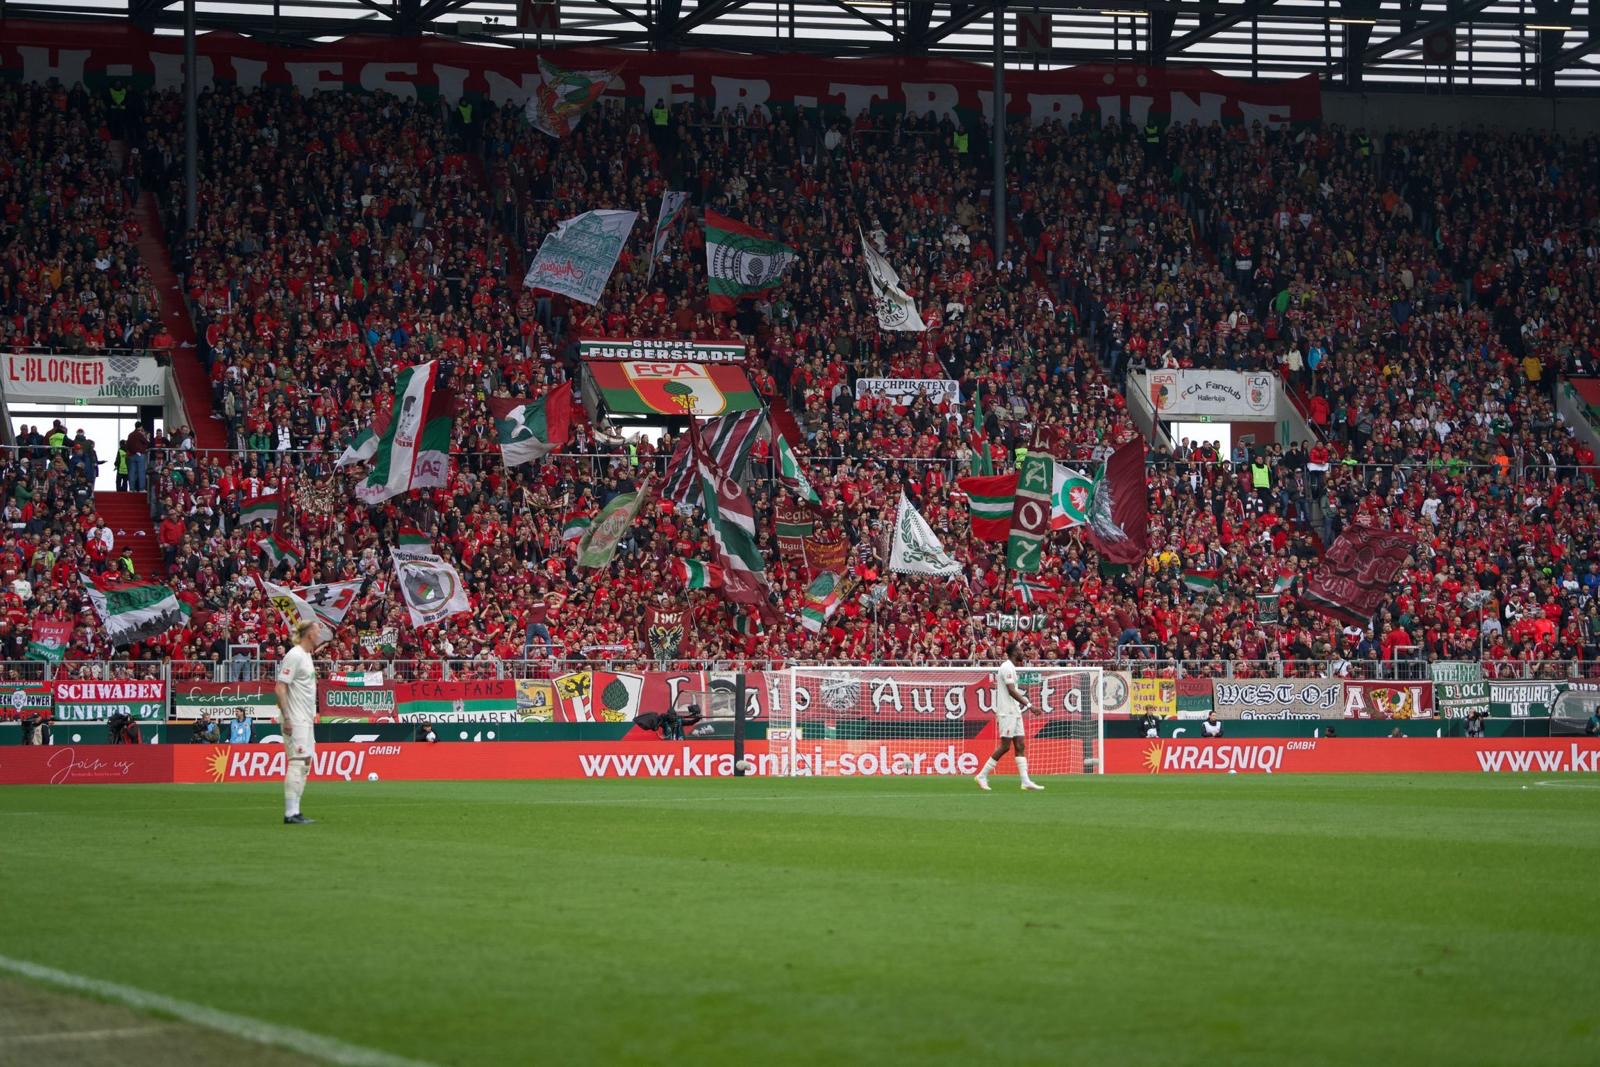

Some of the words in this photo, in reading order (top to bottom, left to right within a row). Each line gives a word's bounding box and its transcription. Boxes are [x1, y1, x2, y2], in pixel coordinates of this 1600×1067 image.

[1017, 16, 1050, 49] N
[632, 340, 693, 349] GRUPPE
[589, 347, 736, 361] FUGGERSTADT
[633, 363, 699, 377] FCA
[1153, 375, 1174, 384] FCA
[1248, 377, 1269, 386] FCA
[98, 384, 160, 397] AUGSBURG
[1181, 383, 1202, 400] FCA
[1205, 381, 1241, 400] Fanclub
[775, 505, 811, 523] Legio
[653, 611, 683, 624] 1907
[58, 683, 164, 699] SCHWABEN
[411, 682, 442, 697] FCA
[464, 681, 505, 695] FANS
[1445, 682, 1484, 698] BLOCK
[1490, 686, 1549, 702] AUGSBURG
[27, 696, 50, 706] POWER
[327, 690, 395, 706] CONCORDIA
[870, 677, 1082, 719] Auguta
[58, 704, 131, 720] UNITED
[140, 704, 161, 718] 07
[1510, 702, 1529, 716] OST
[402, 712, 518, 723] NORDSCHWABEN
[229, 751, 365, 781] KRANIQI
[369, 746, 401, 755] GMBH
[579, 747, 978, 777] www.krasniqi-solar.de
[1163, 745, 1284, 773] KRASNIQI
[1286, 741, 1316, 750] GMBH
